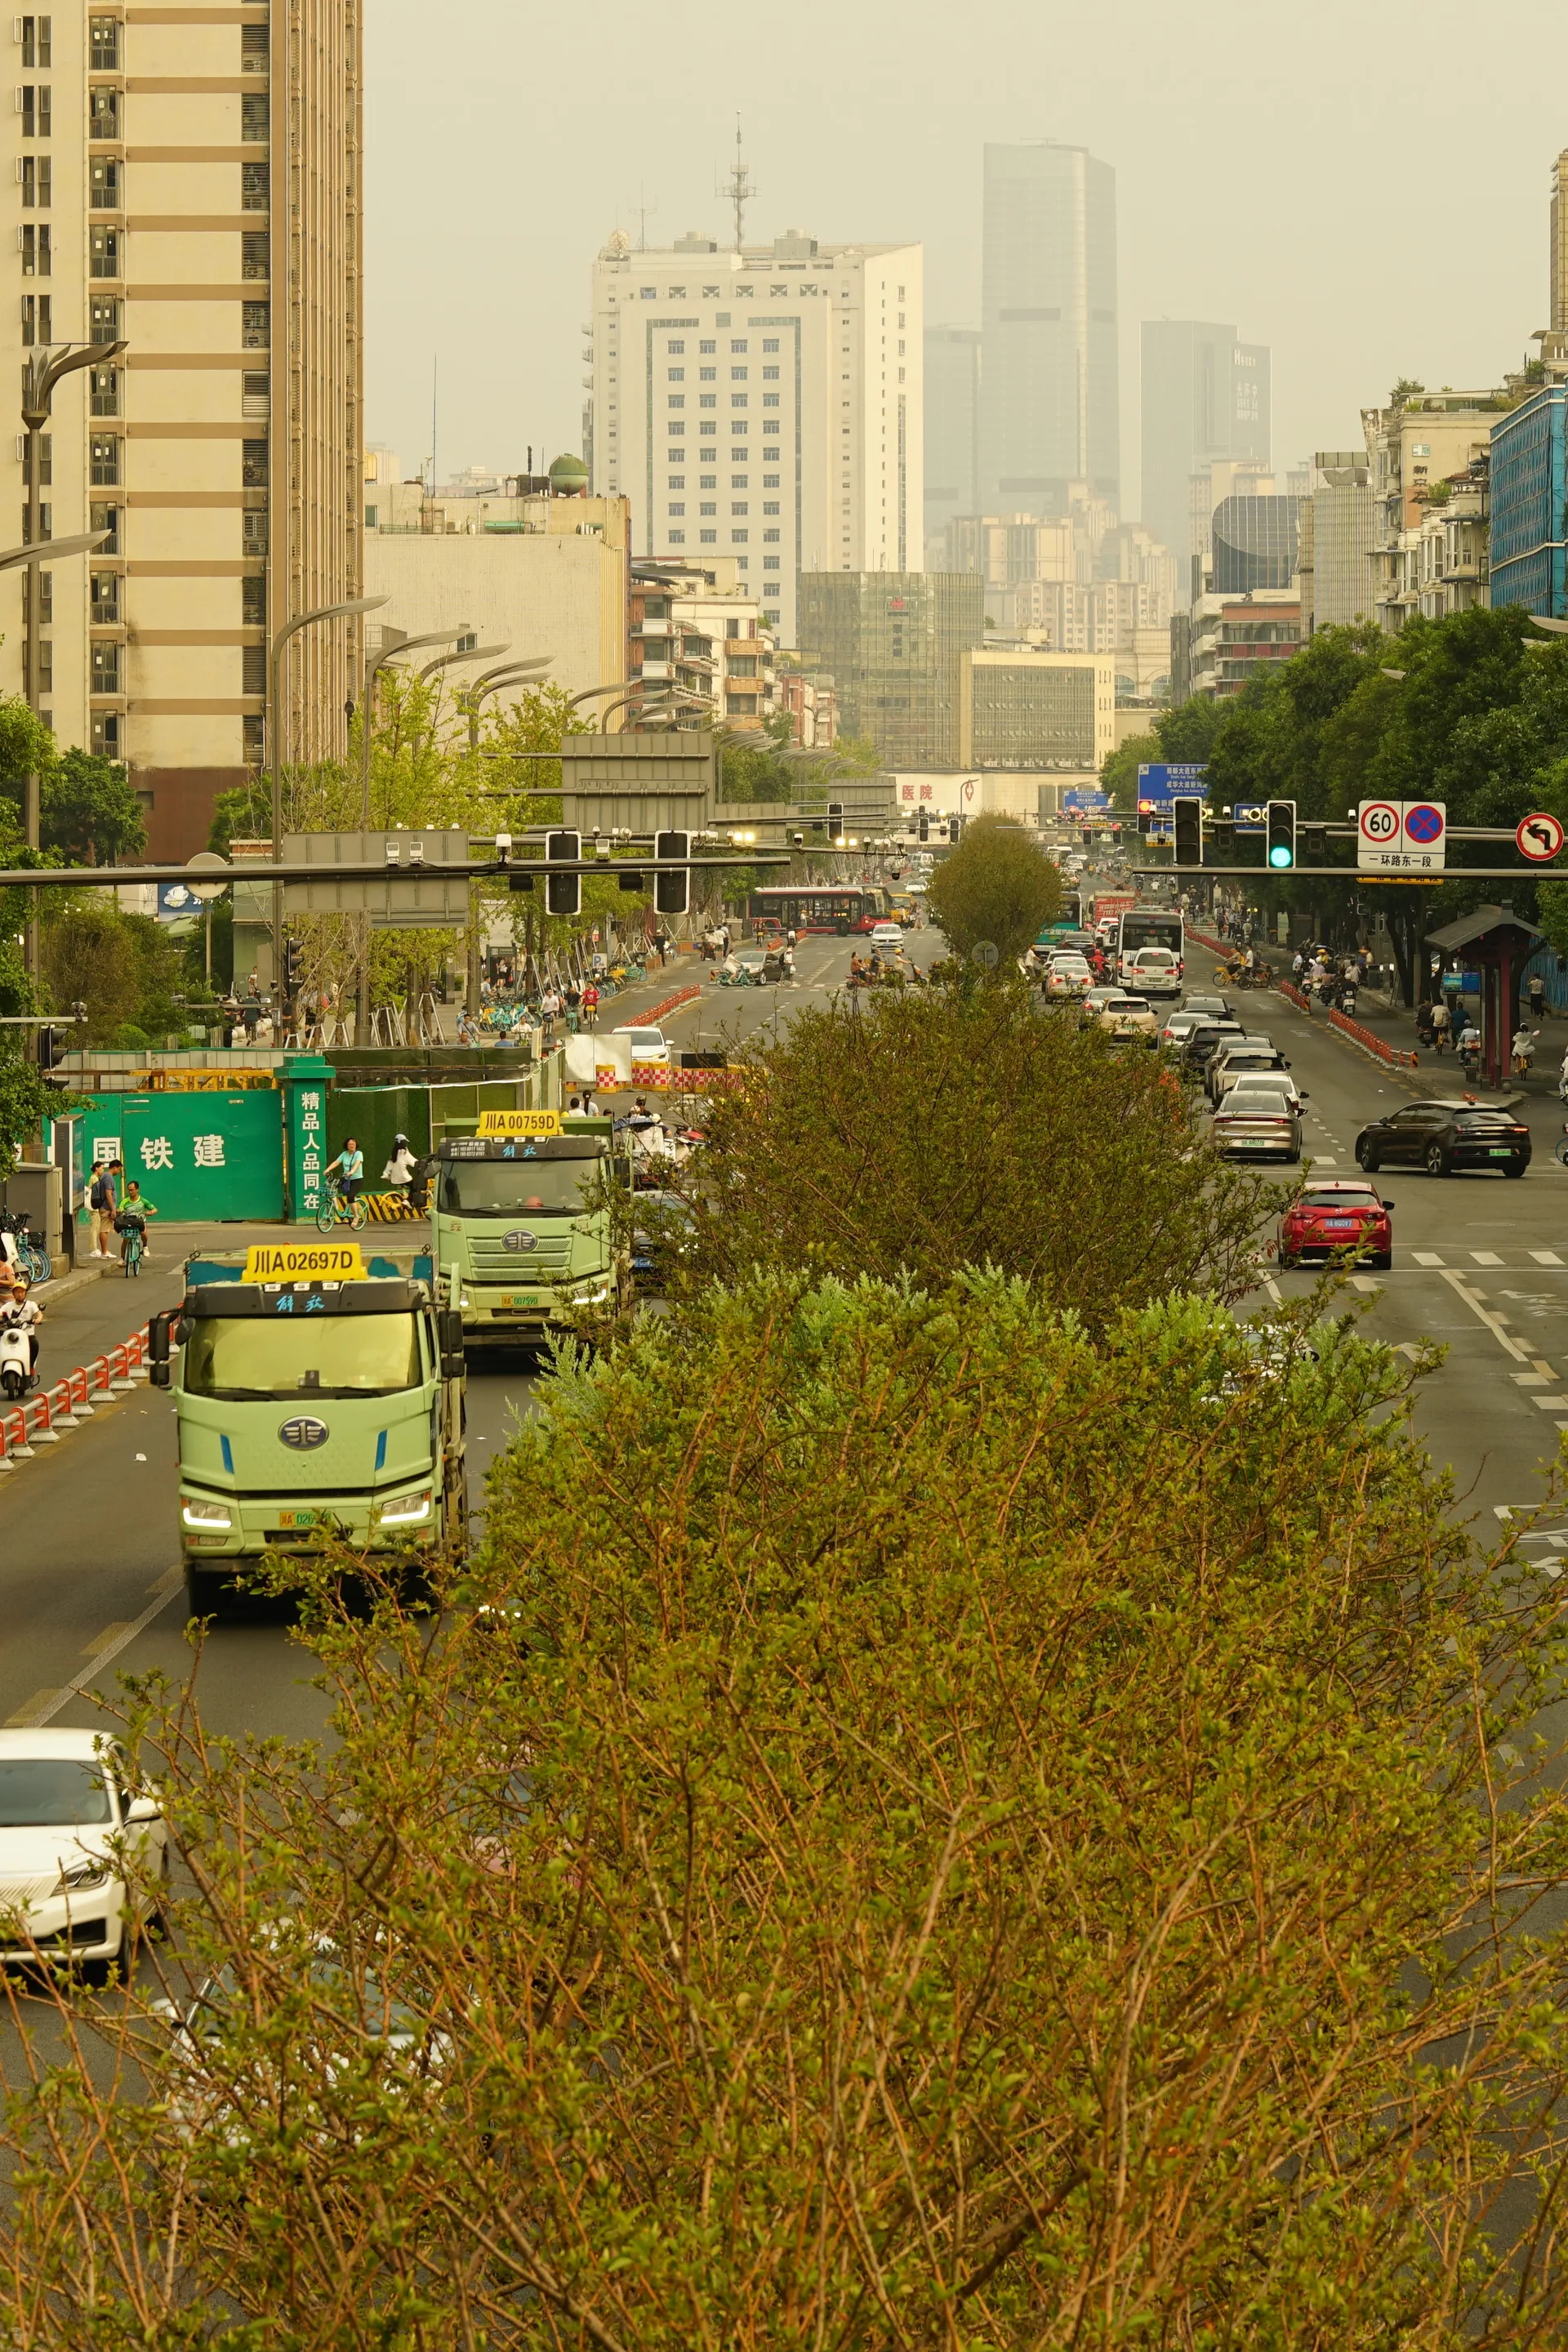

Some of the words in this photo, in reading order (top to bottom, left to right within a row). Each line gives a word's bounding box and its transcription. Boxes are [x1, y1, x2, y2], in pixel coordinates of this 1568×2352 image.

[902, 784, 933, 800] 医院
[1370, 813, 1391, 833] 60
[1369, 854, 1432, 867] 一环路东一段
[485, 1113, 555, 1130] 川A00759D
[301, 1092, 320, 1209] 精品人品同在
[253, 1250, 354, 1274] 川A02697D
